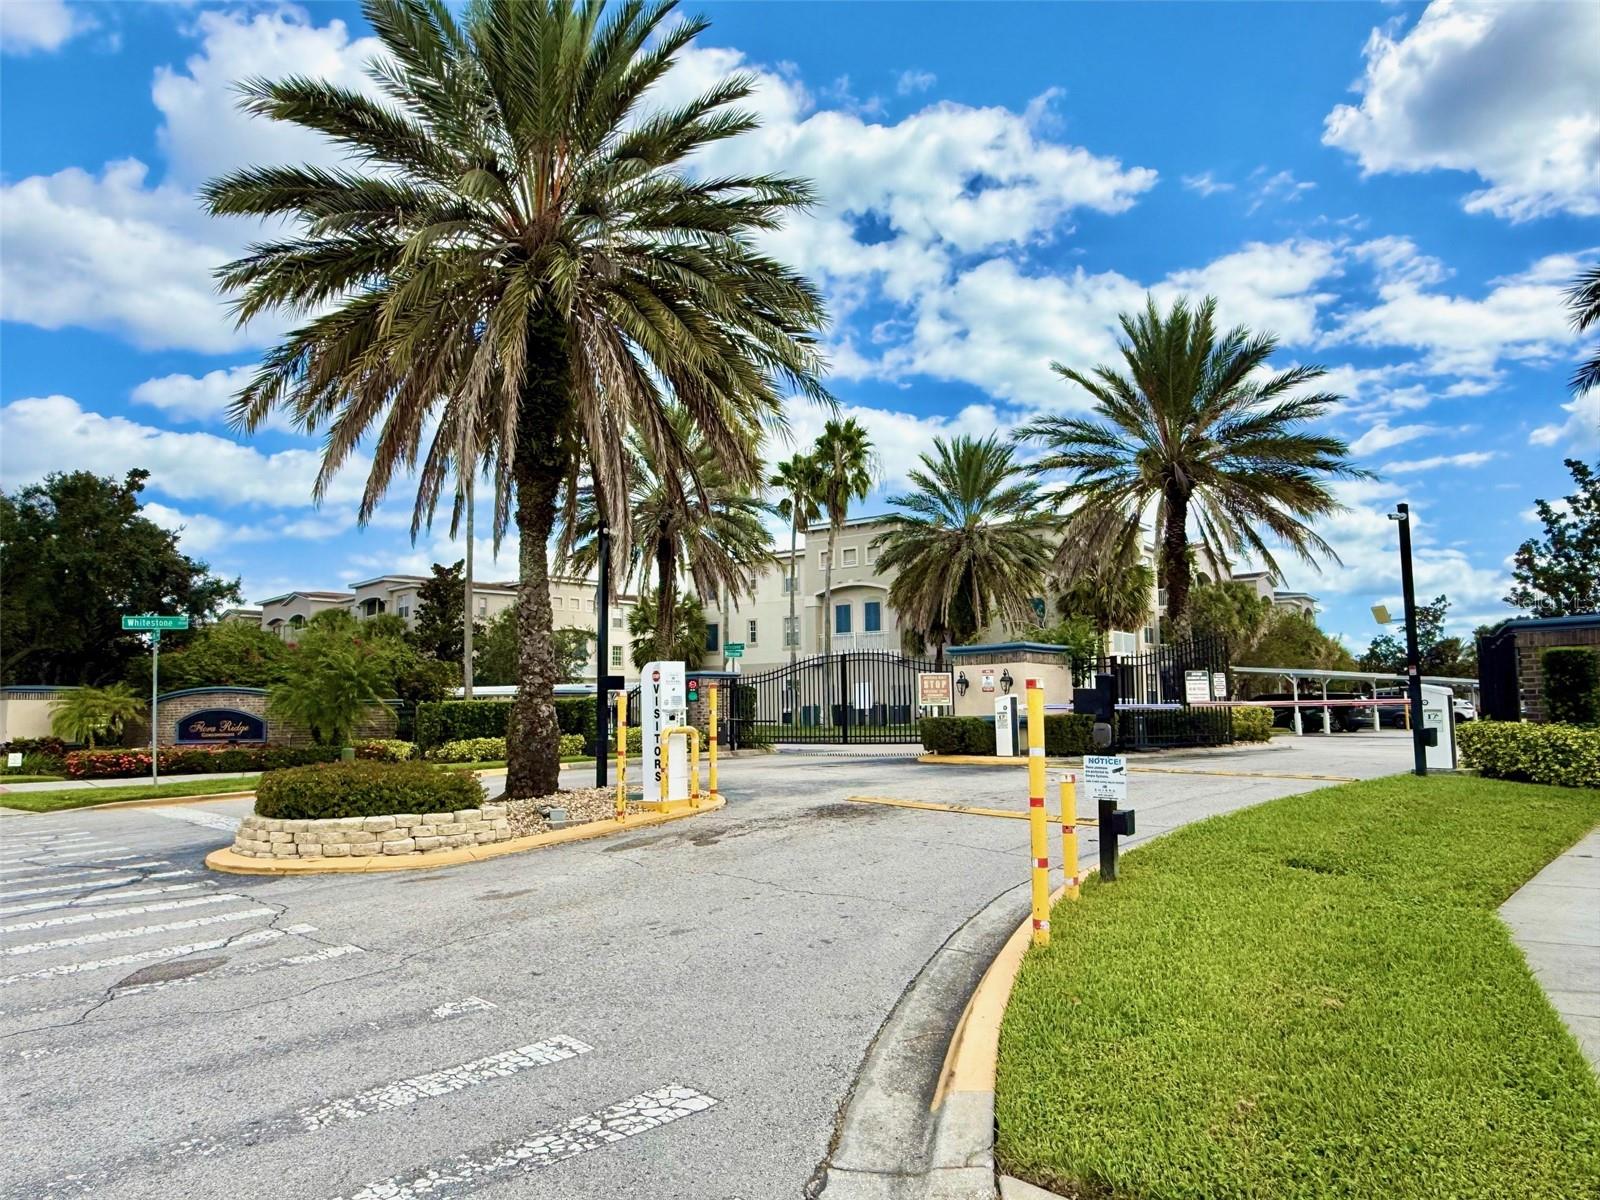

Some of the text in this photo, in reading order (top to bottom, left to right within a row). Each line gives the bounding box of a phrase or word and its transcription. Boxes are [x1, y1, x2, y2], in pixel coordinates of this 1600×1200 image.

[127, 619, 173, 627] Whitestone
[219, 720, 250, 736] Ridge
[653, 683, 661, 782] VISITORS
[1088, 757, 1122, 766] NOTICE!
